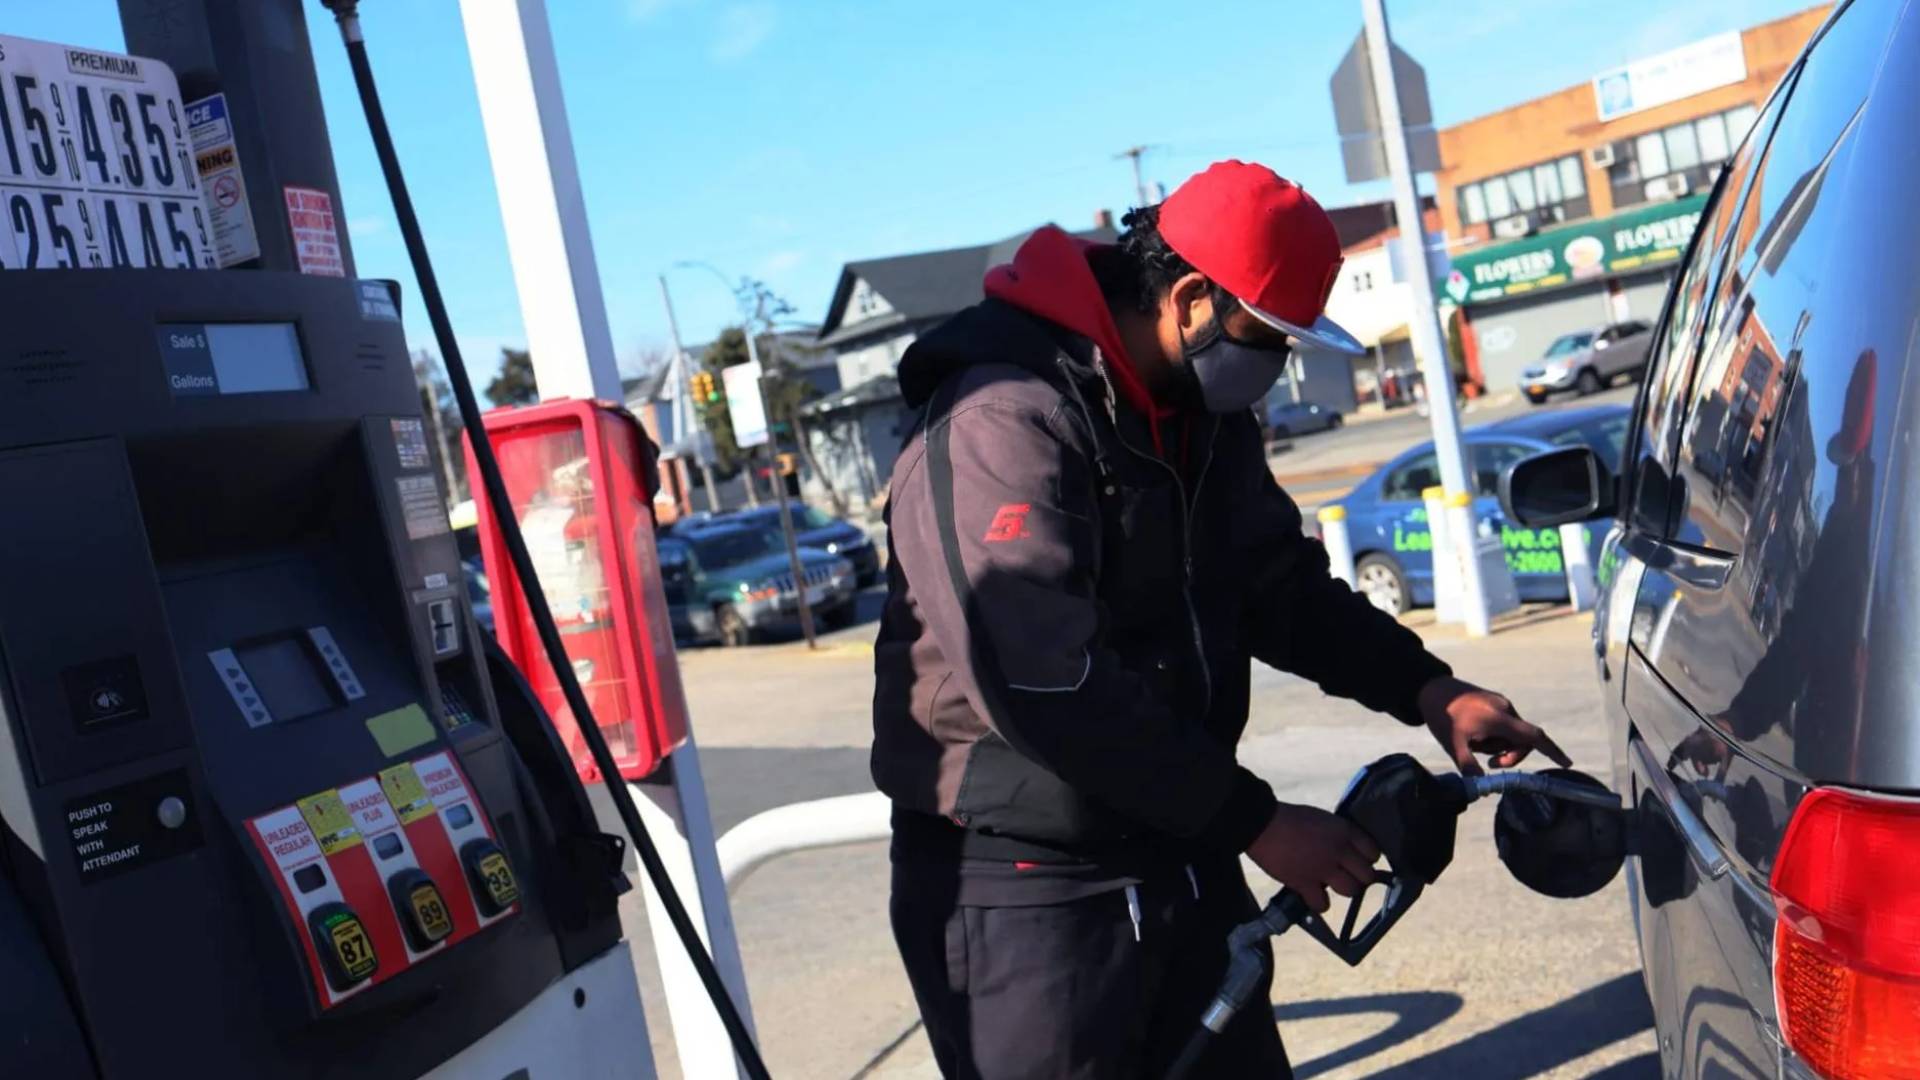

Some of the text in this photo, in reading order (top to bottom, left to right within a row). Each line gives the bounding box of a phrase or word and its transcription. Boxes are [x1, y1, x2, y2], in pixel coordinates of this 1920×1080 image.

[69, 50, 139, 76] PREMIUM
[76, 86, 174, 187] 4.35
[1474, 249, 1555, 284] FLOWERS
[170, 334, 196, 349] Sale
[171, 374, 215, 389] Gallons
[68, 801, 113, 823] PUSH TO
[72, 821, 109, 840] SPEAK
[76, 839, 105, 856] WITH
[82, 844, 141, 873] ATTENDANT
[487, 867, 512, 894] 93
[420, 899, 444, 926] 89
[340, 933, 367, 965] 87
